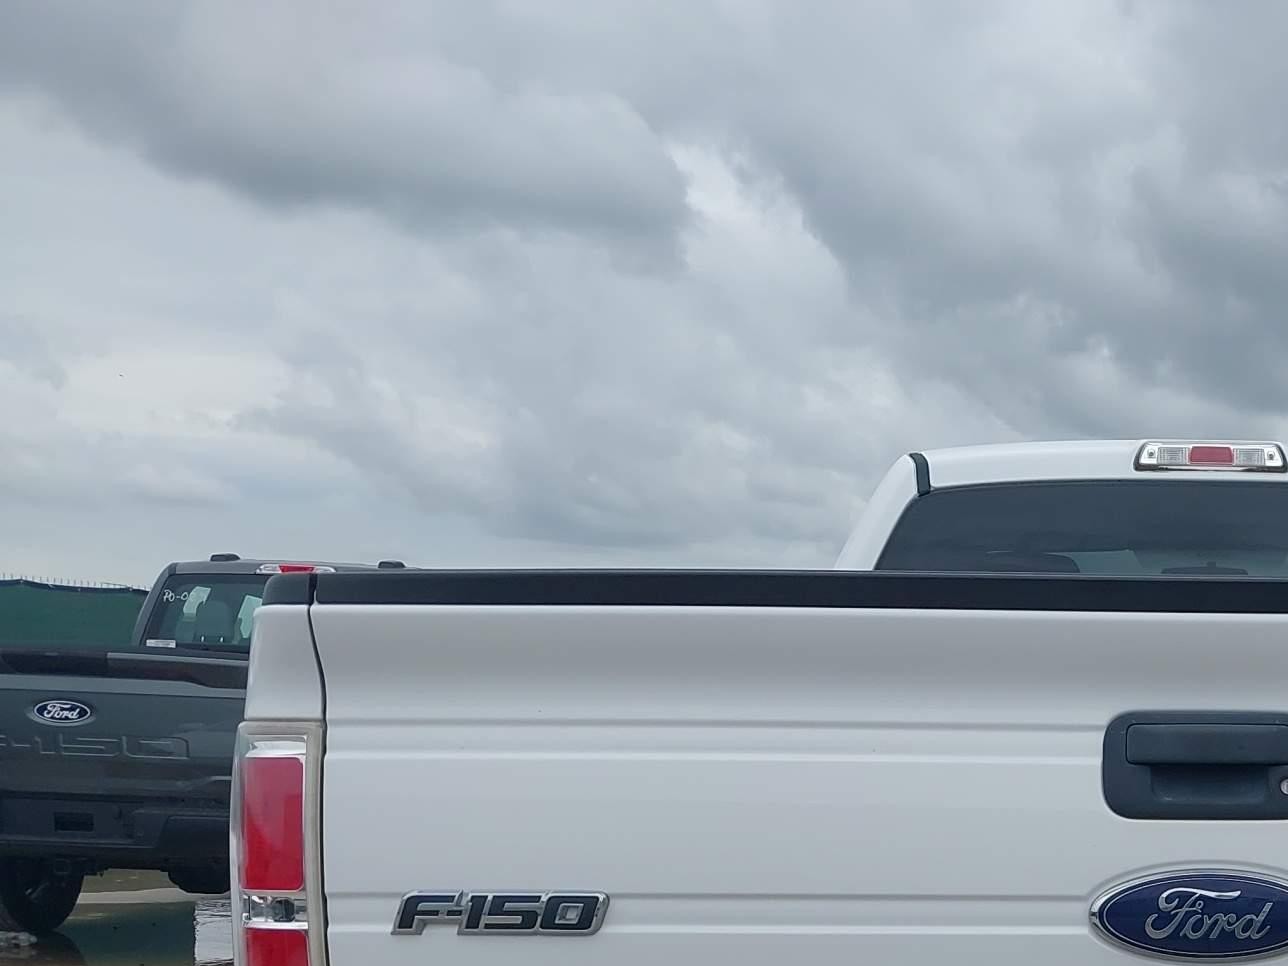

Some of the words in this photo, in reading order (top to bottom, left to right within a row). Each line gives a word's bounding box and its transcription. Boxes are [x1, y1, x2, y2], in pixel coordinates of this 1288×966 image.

[44, 703, 81, 719] Ford
[0, 734, 190, 760] -150
[391, 889, 610, 936] F-150
[1144, 887, 1273, 940] Ford
